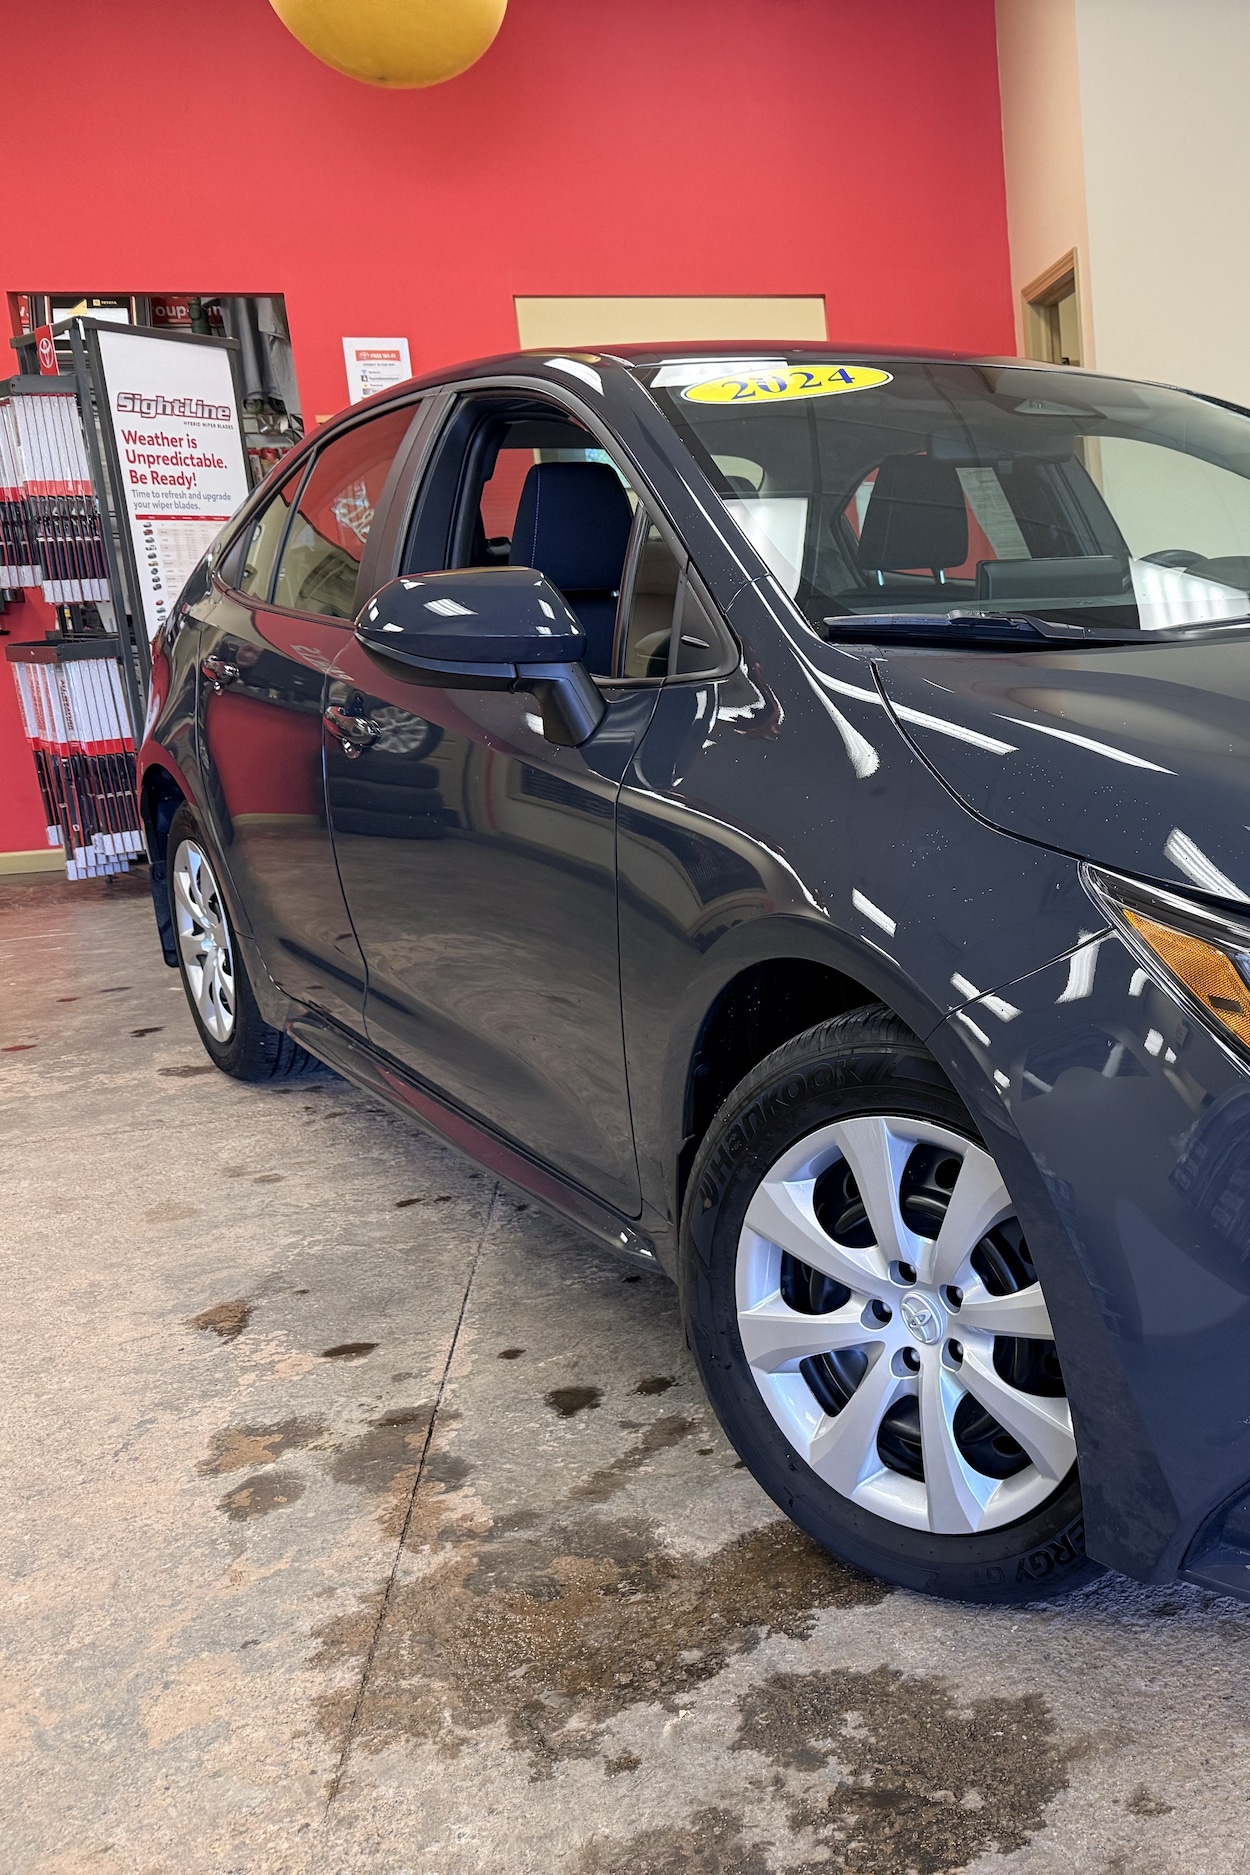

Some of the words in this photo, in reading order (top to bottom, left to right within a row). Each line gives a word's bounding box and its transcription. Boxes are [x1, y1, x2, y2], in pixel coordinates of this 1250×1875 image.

[721, 367, 856, 400] 2024
[116, 391, 231, 421] SightLine
[121, 429, 184, 448] Weather
[186, 433, 198, 449] is
[125, 449, 228, 469] Unpredictable.
[129, 469, 148, 485] Be
[150, 470, 197, 490] Ready!
[131, 489, 151, 499] Time
[151, 491, 160, 499] to
[161, 490, 187, 500] refresh
[188, 491, 201, 500] and
[202, 492, 231, 503] upgrade
[133, 501, 151, 511] your
[151, 501, 173, 511] wiper
[174, 500, 201, 510] blades.
